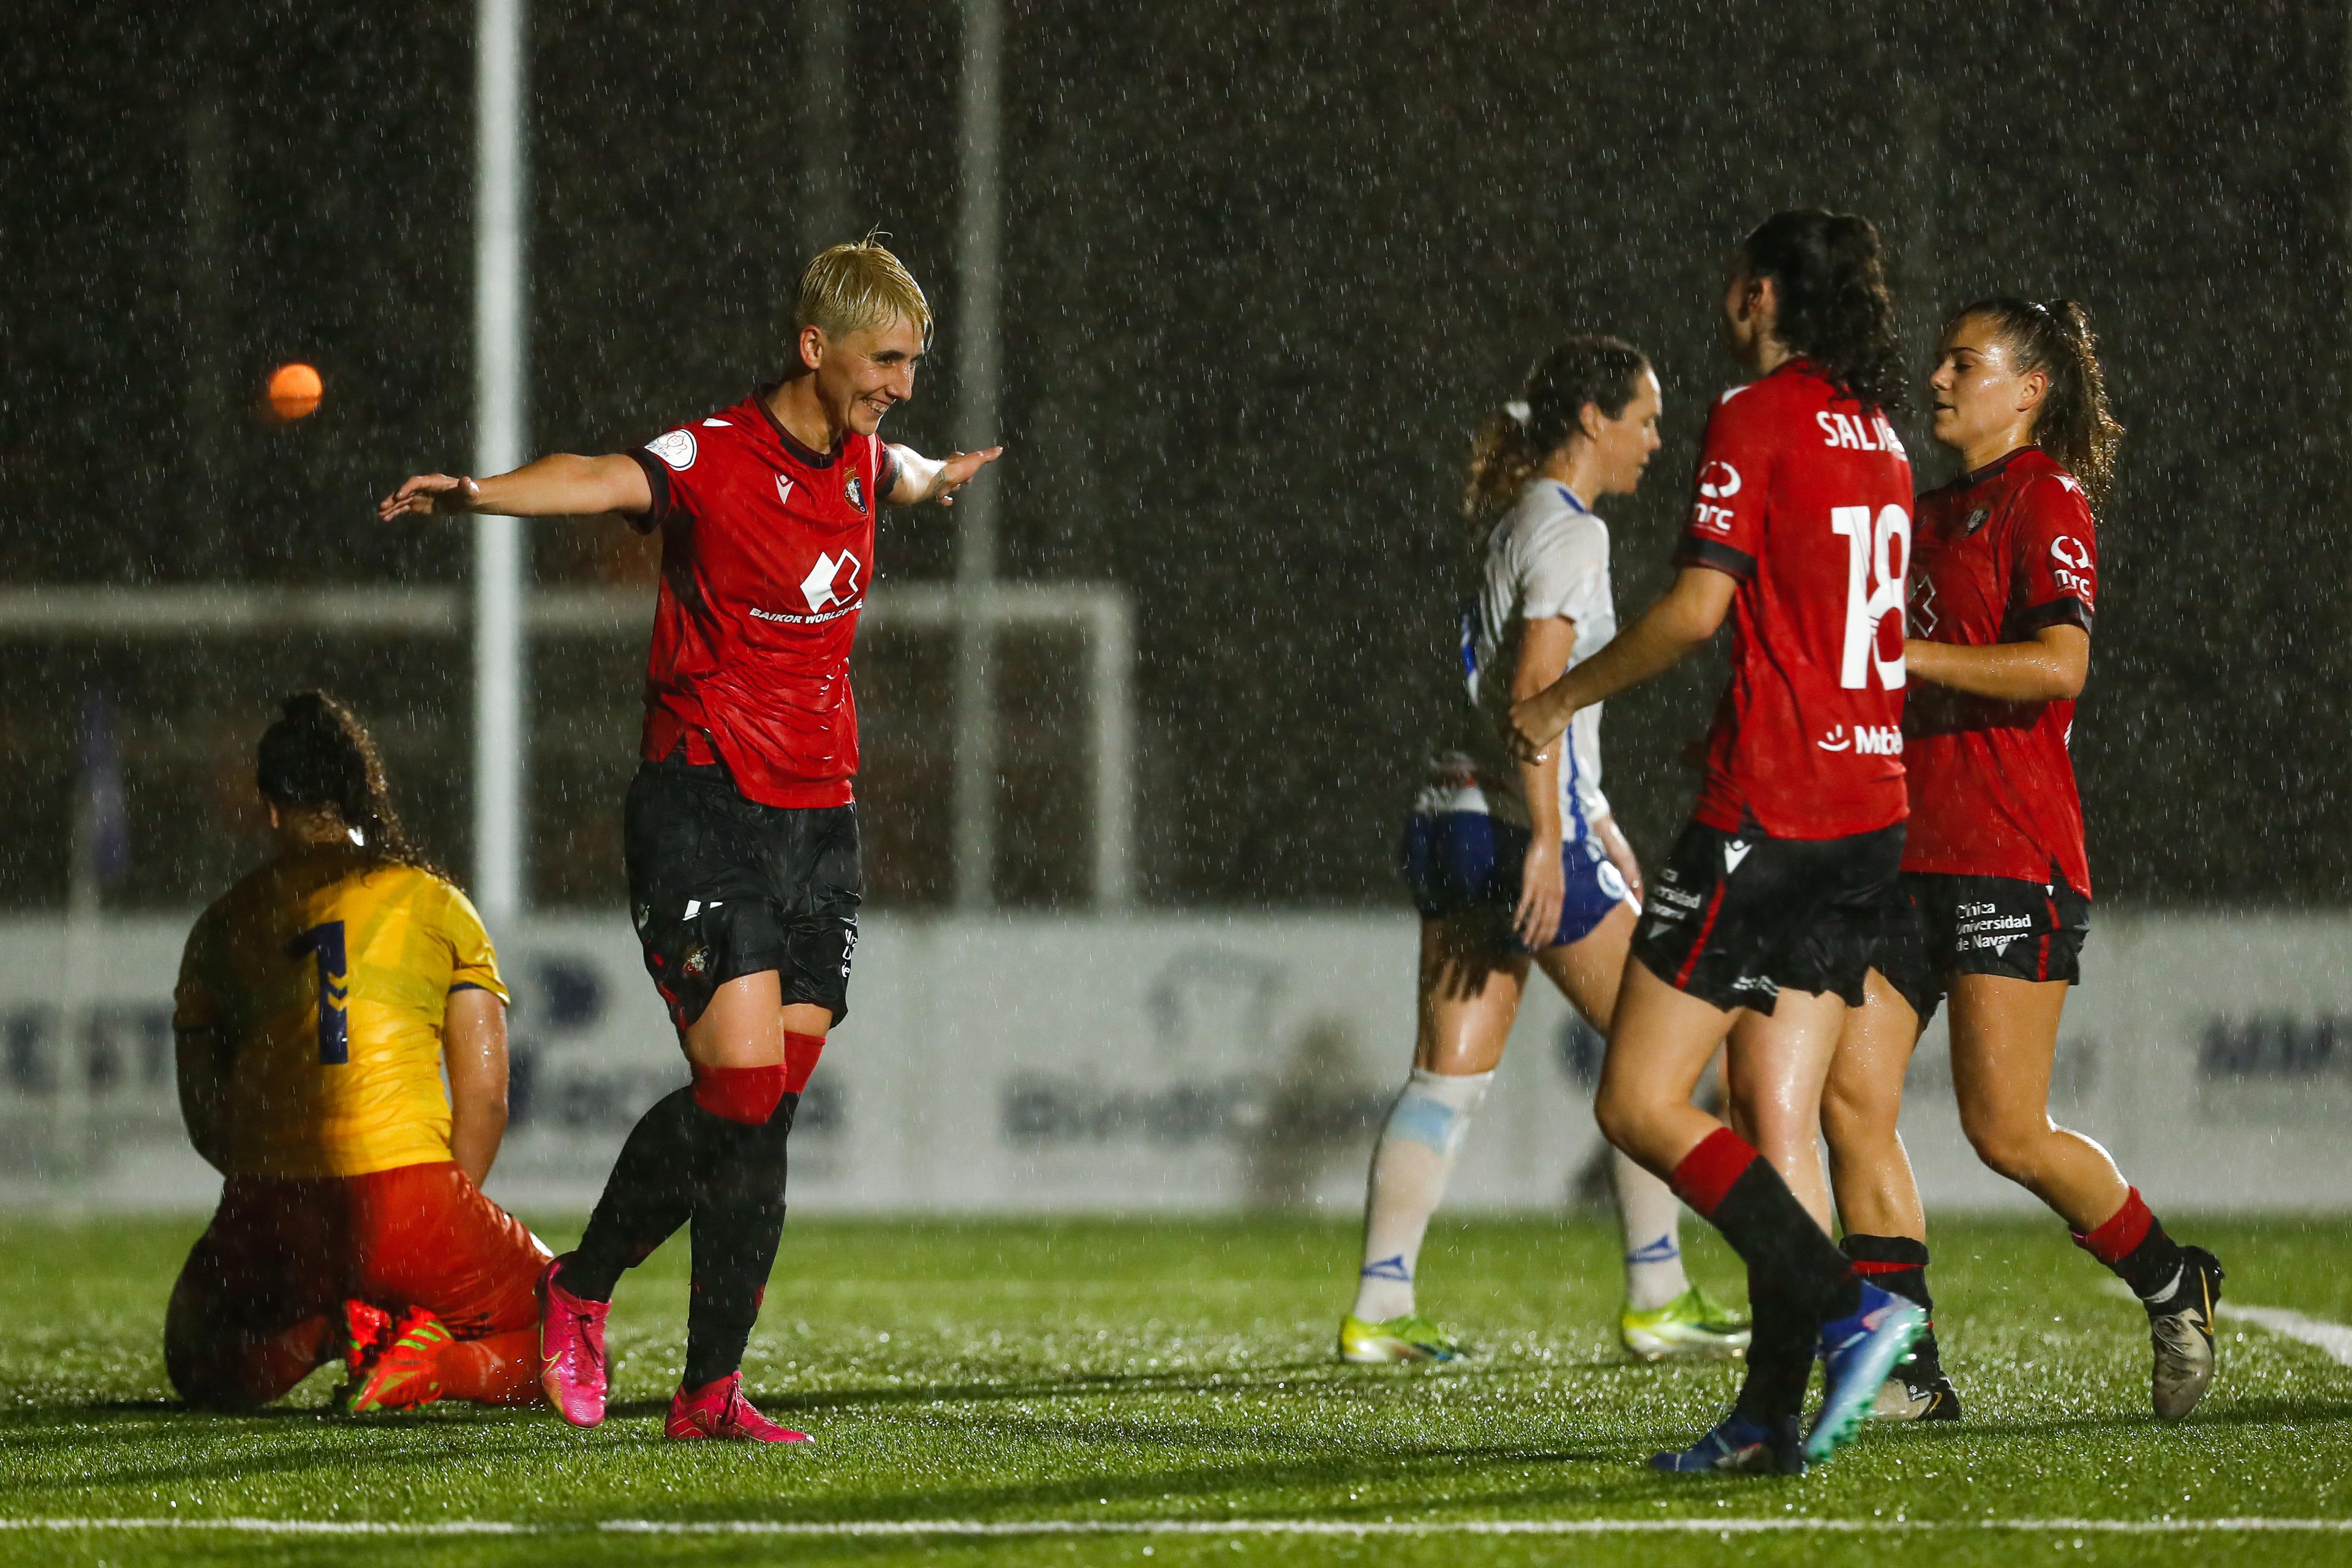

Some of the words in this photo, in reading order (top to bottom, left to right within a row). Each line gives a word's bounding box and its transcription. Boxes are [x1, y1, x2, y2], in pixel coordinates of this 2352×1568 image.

[1831, 503, 1911, 691] 18
[2054, 569, 2090, 597] mrc
[750, 608, 802, 624] BAIKOR
[805, 598, 863, 624] WORLDE
[1956, 938, 1969, 952] de
[287, 921, 348, 1065] 1
